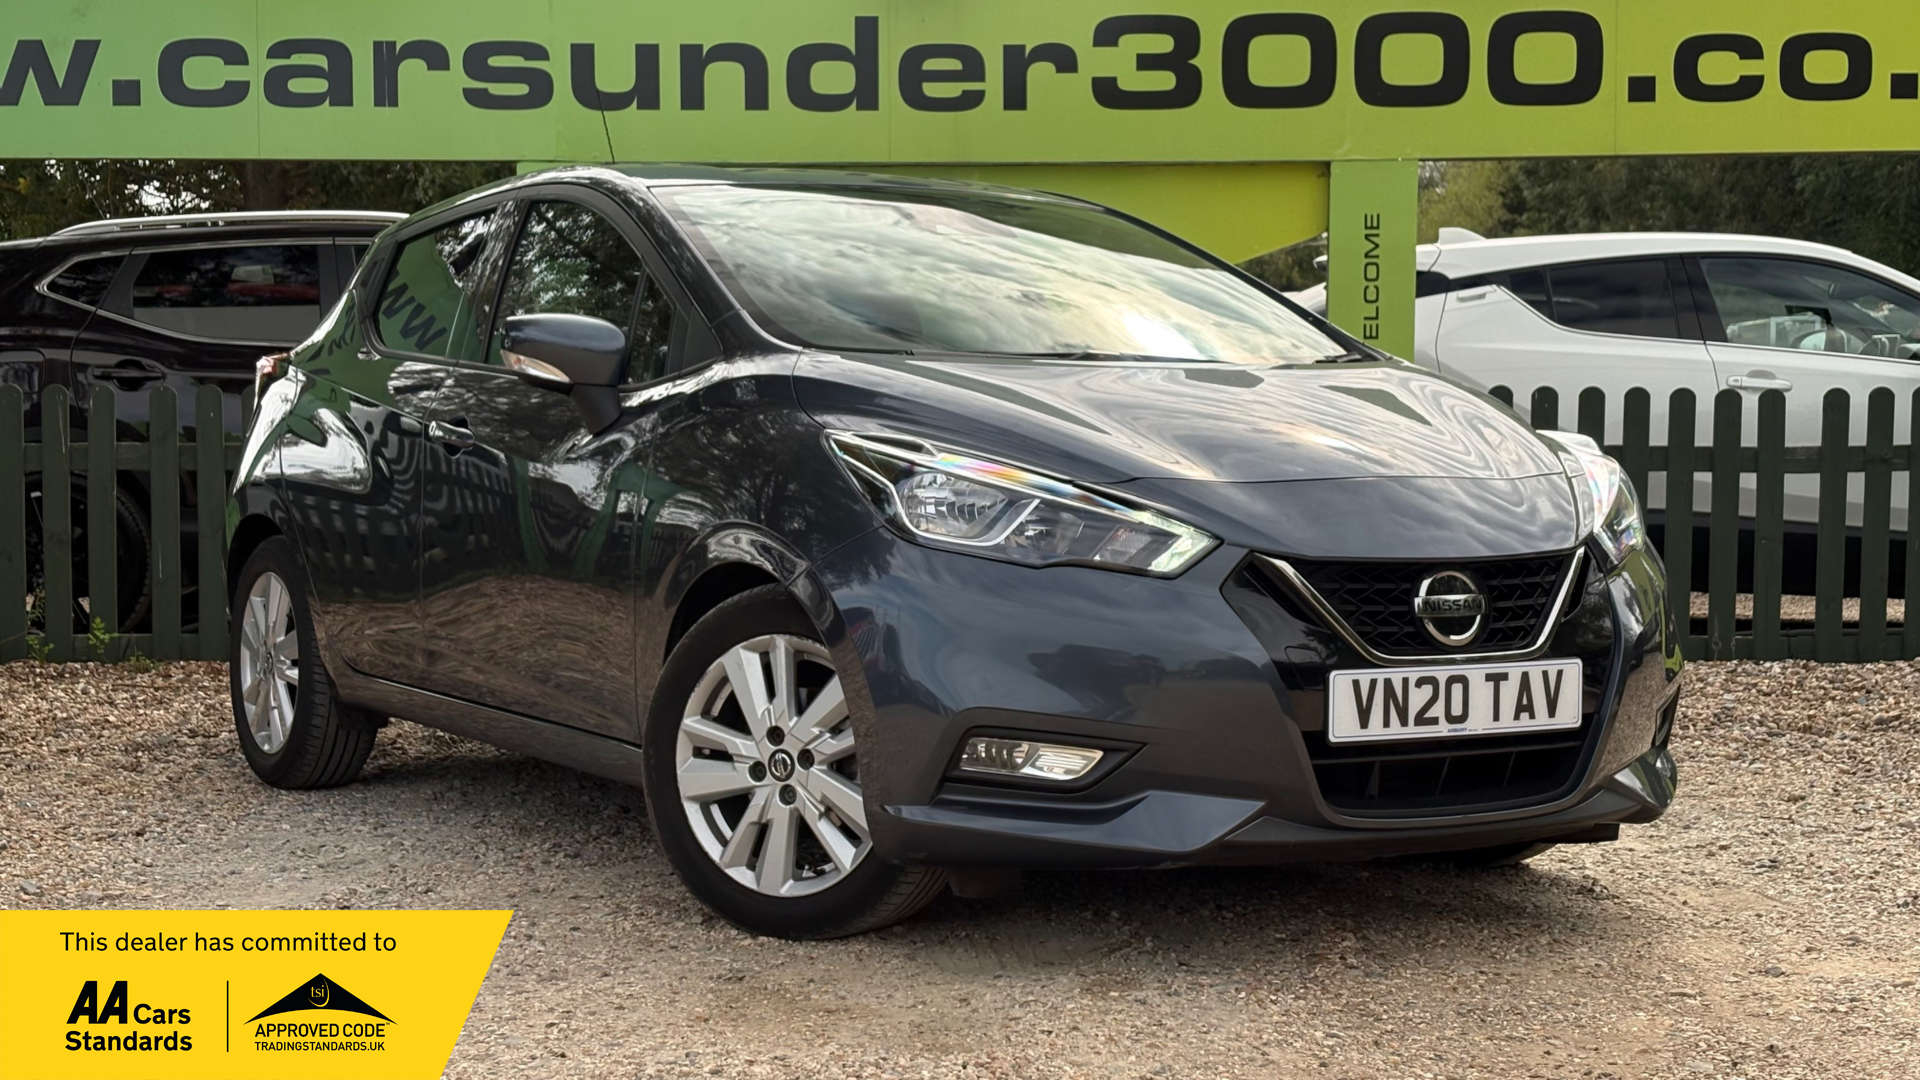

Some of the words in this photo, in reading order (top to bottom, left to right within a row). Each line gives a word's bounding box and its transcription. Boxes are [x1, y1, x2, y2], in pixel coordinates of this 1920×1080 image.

[1363, 213, 1380, 344] ELCOME
[1424, 597, 1483, 612] NISSAN
[1352, 674, 1470, 730] VN20
[1485, 669, 1564, 722] TAV
